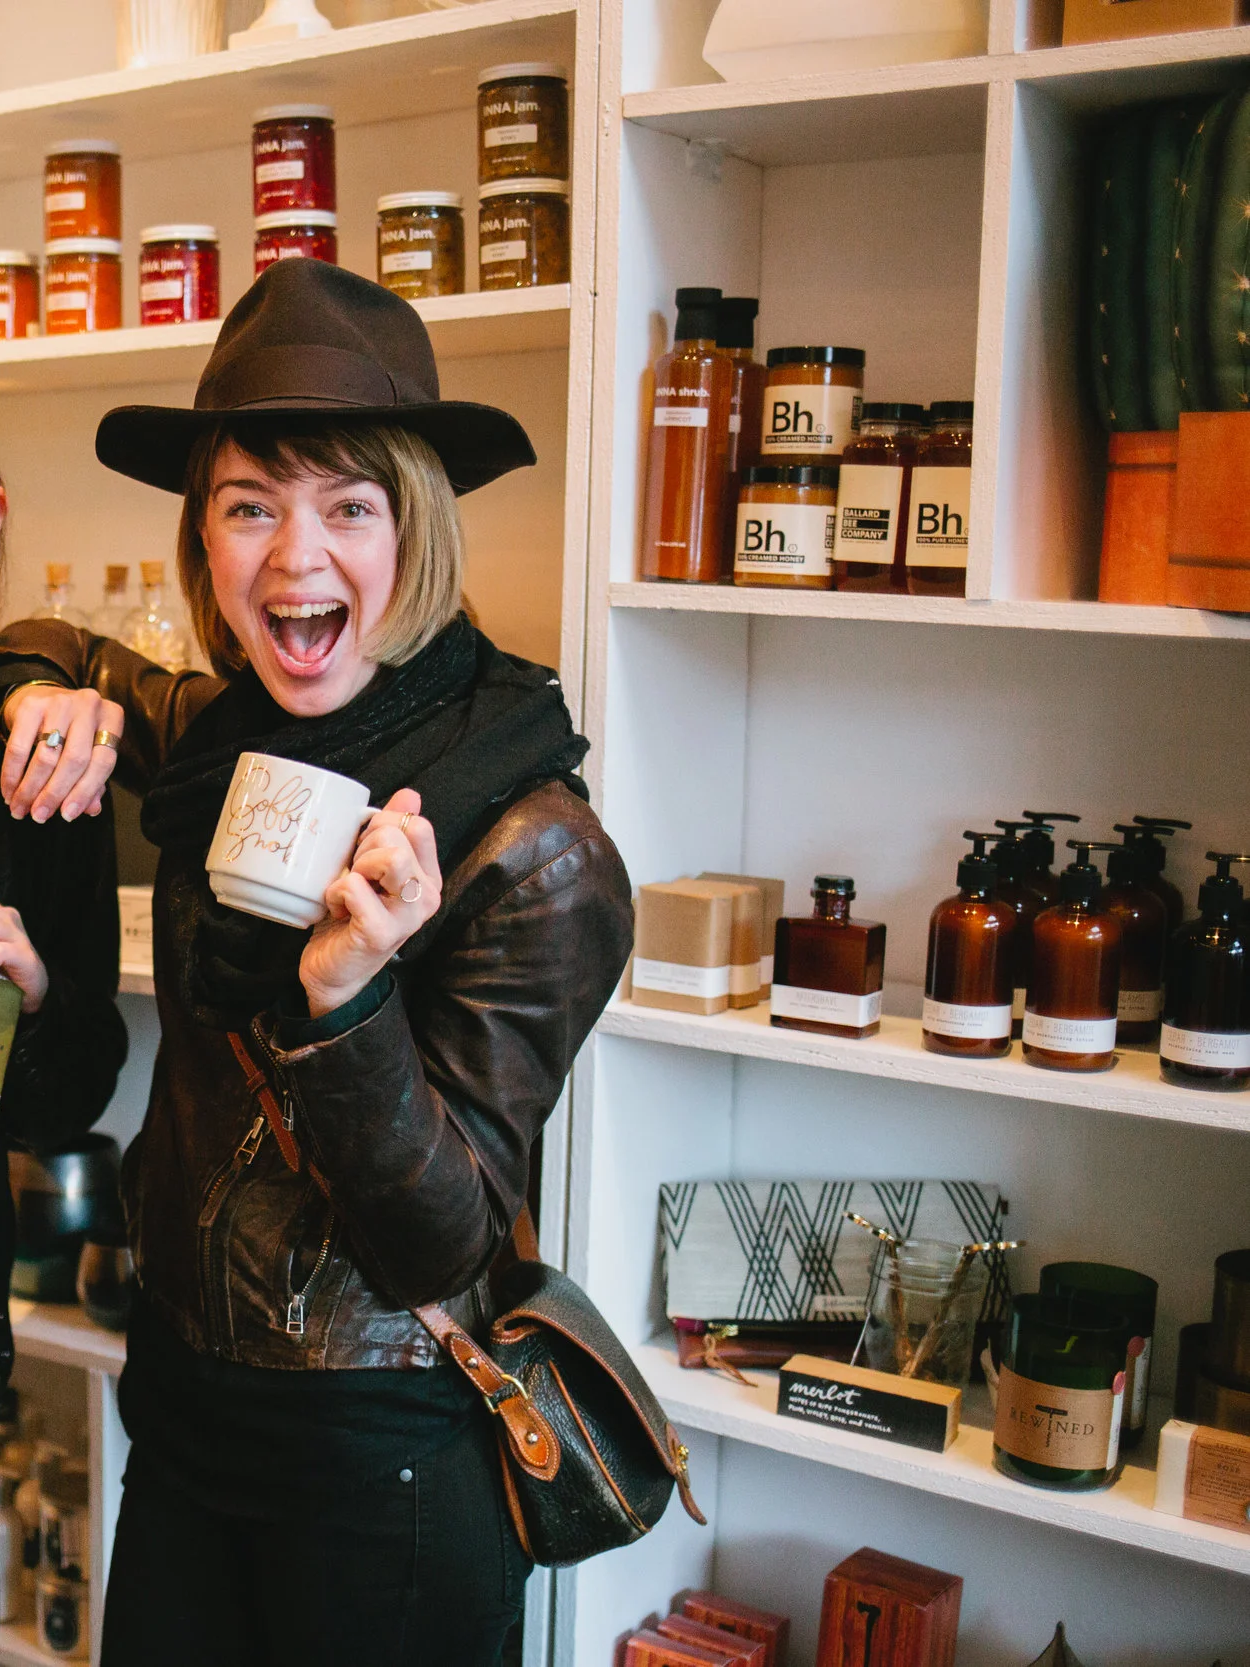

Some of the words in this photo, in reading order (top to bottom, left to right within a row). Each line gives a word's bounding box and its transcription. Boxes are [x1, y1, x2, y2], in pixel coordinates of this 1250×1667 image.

[514, 100, 540, 114] jam.
[503, 217, 530, 232] jam.
[678, 386, 710, 397] shrub.
[772, 401, 813, 432] Bh
[844, 508, 880, 518] BALLARD
[917, 504, 962, 535] Bh
[843, 520, 858, 528] BEE
[744, 520, 785, 552] Bh
[842, 530, 883, 540] COMPANY
[789, 1382, 862, 1405] merlot
[1010, 1406, 1095, 1436] REWINED
